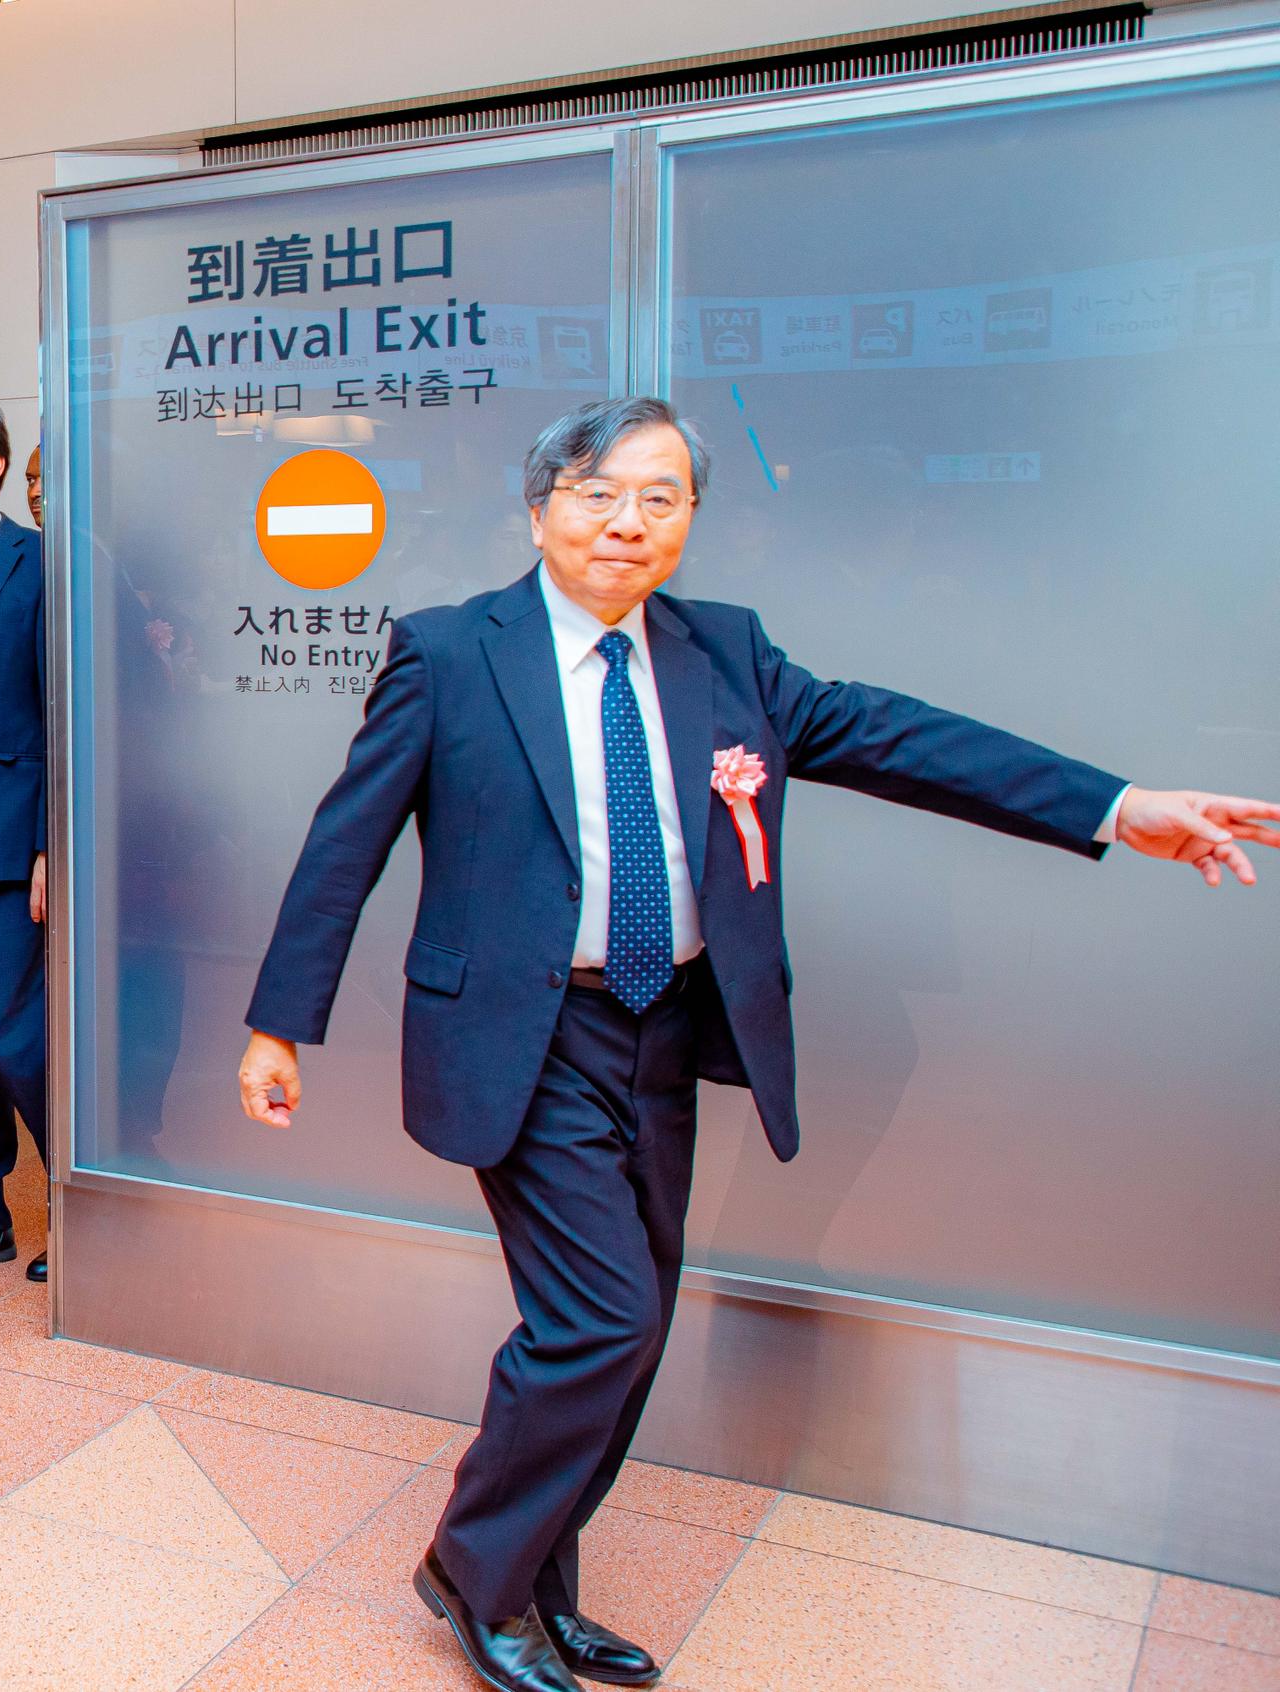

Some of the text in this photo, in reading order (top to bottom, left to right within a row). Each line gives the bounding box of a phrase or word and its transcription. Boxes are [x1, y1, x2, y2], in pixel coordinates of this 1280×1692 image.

[188, 221, 452, 304] 到着出口
[164, 307, 348, 370] Arrival
[376, 298, 486, 352] Exit
[157, 368, 498, 422] 到达出口 도착출구
[236, 674, 377, 694] 禁止入内 진입
[261, 644, 380, 673] No Entry
